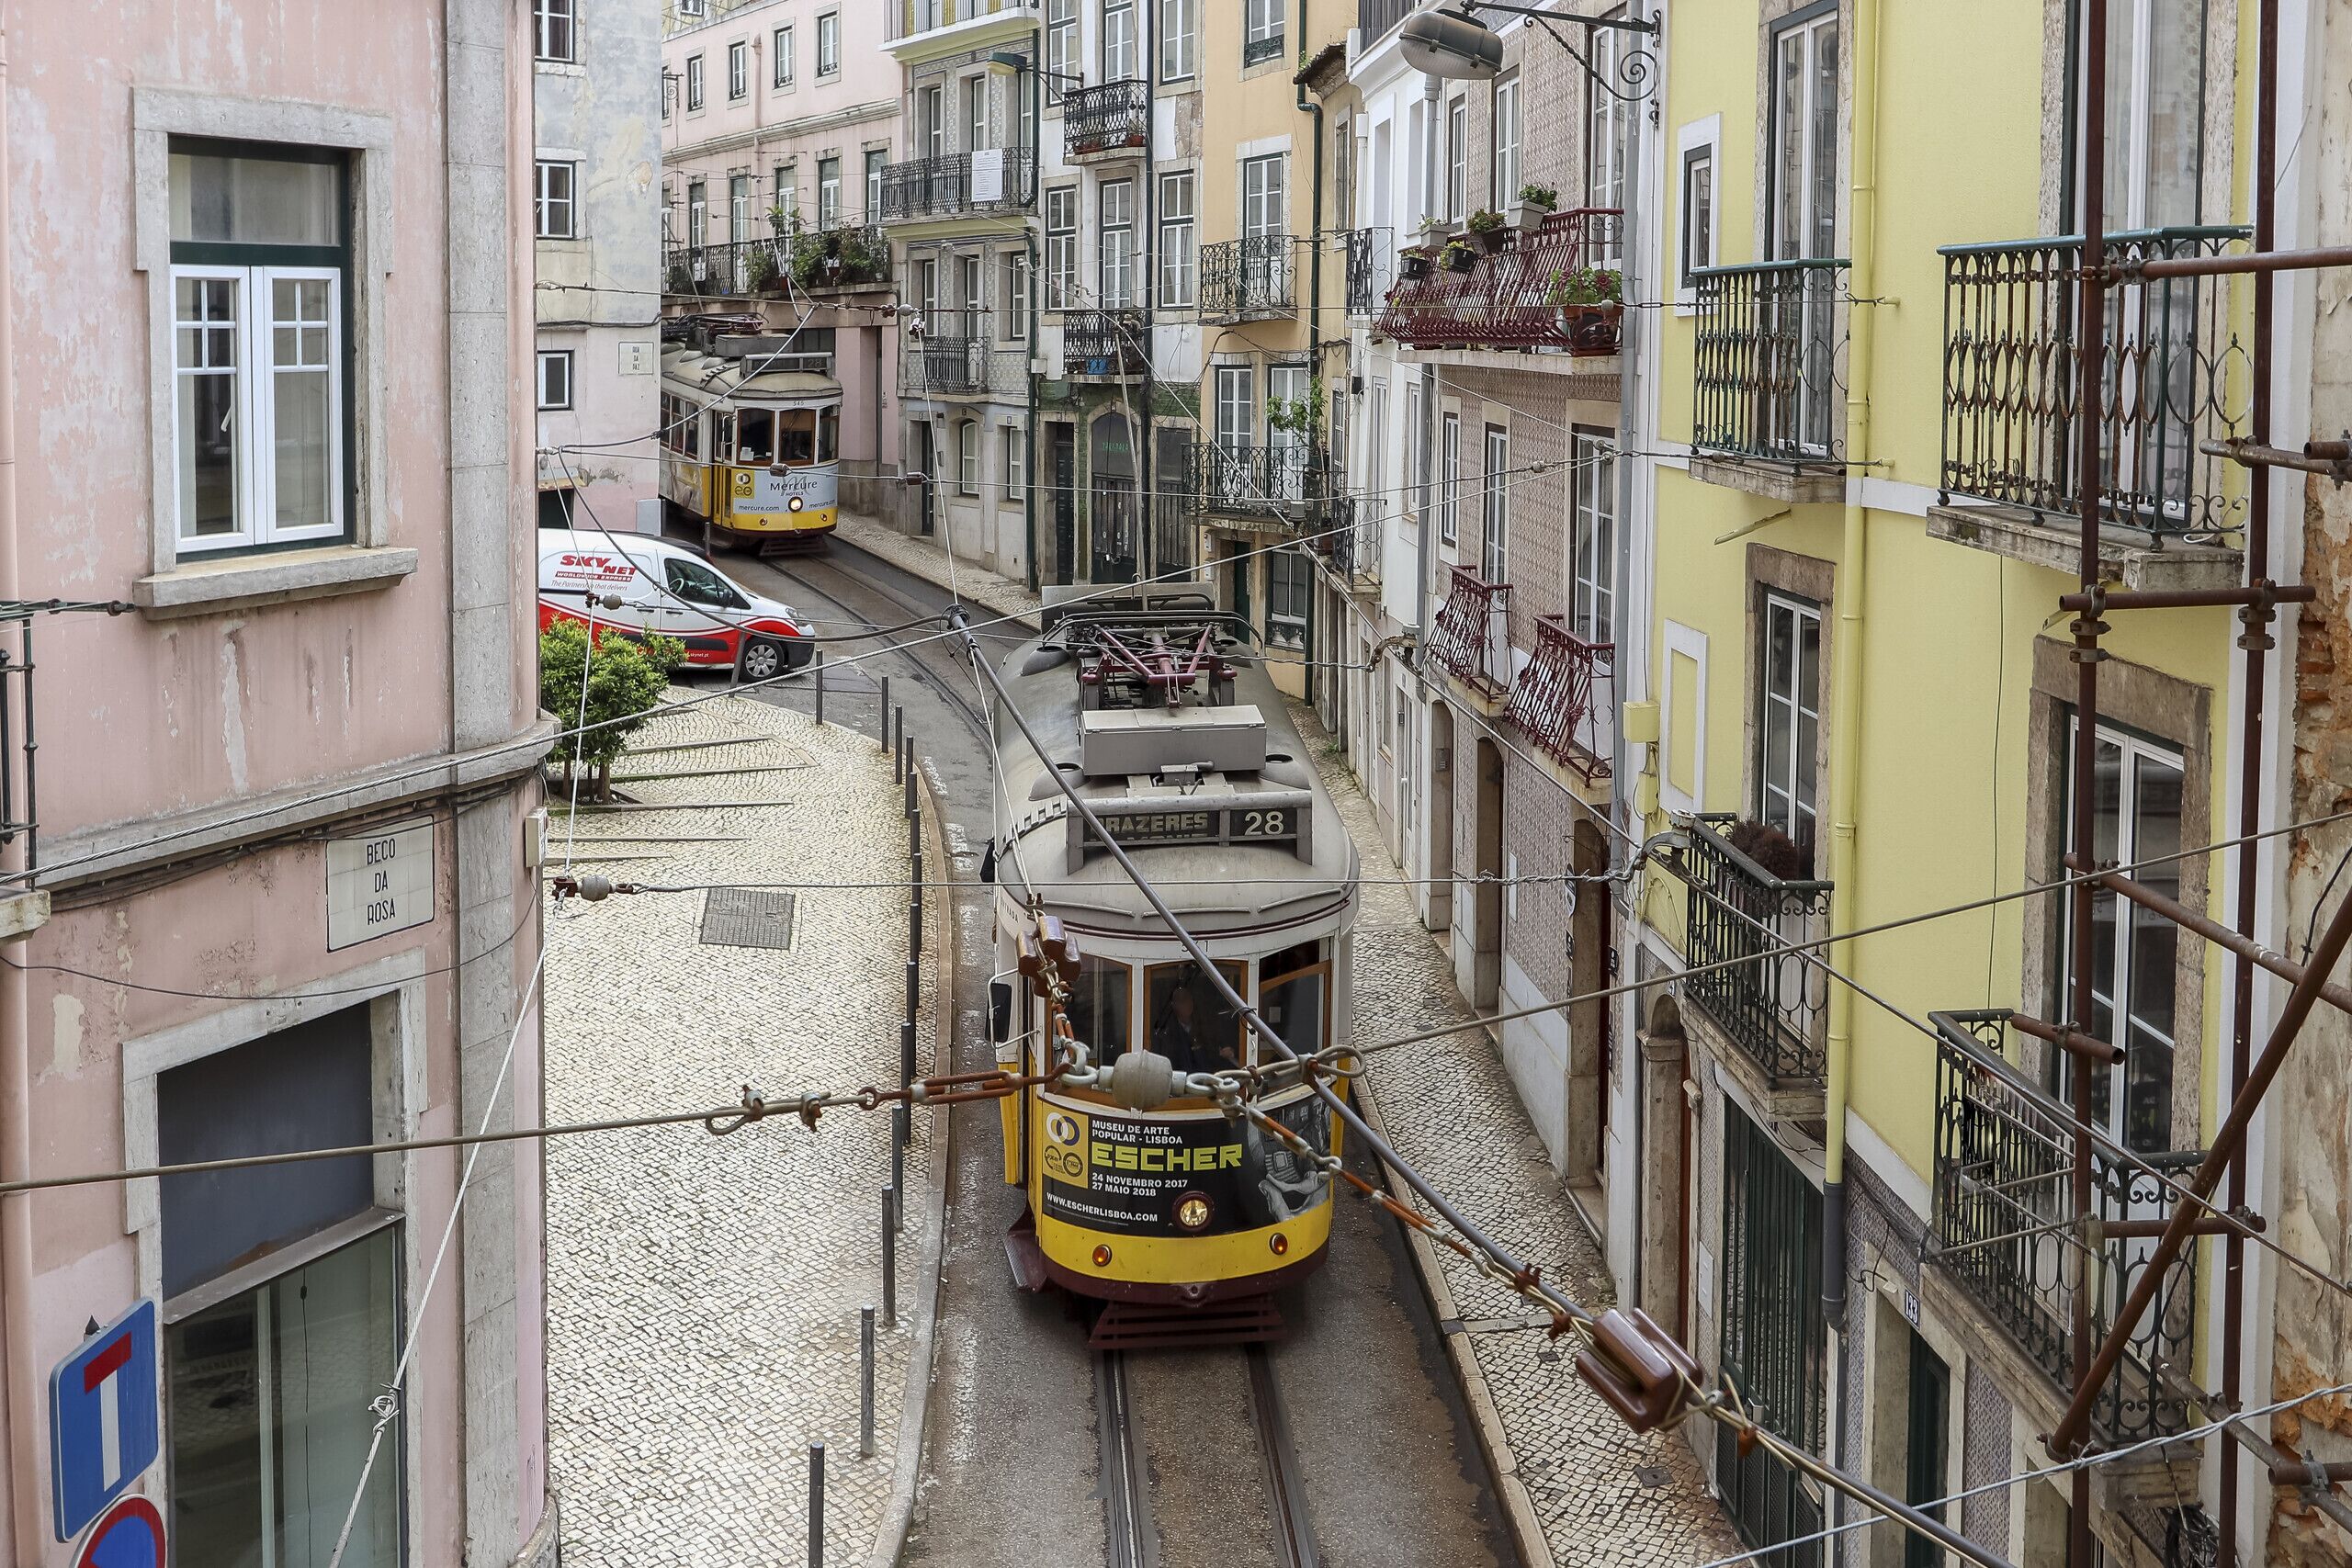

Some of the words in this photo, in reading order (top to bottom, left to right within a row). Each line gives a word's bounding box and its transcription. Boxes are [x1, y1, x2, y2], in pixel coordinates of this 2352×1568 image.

[770, 480, 818, 491] Mercure
[560, 555, 612, 569] SKY
[557, 571, 599, 580] WORLDWIDE
[602, 566, 636, 575] NET
[561, 581, 594, 591] Partnership
[1244, 811, 1284, 836] 28
[367, 838, 395, 865] BECO
[375, 870, 388, 893] DA
[368, 898, 395, 925] ROSA
[1091, 1120, 1125, 1134] MUSEU
[1127, 1124, 1141, 1134] DE
[1142, 1125, 1170, 1135] ARTE
[1091, 1128, 1136, 1144] POPULAR
[1145, 1135, 1183, 1145] LISBOA
[1091, 1141, 1243, 1172] ESCHER
[1091, 1172, 1104, 1182] 24
[1105, 1174, 1162, 1188] NOVEMBRO
[1164, 1179, 1188, 1188] 2017
[1091, 1181, 1102, 1190] 27
[1104, 1183, 1130, 1195] MAIO
[1132, 1187, 1157, 1197] 2018
[1046, 1191, 1159, 1222] WWW.ESCHERLISBOA.COM
[1905, 1291, 1917, 1323] 133
